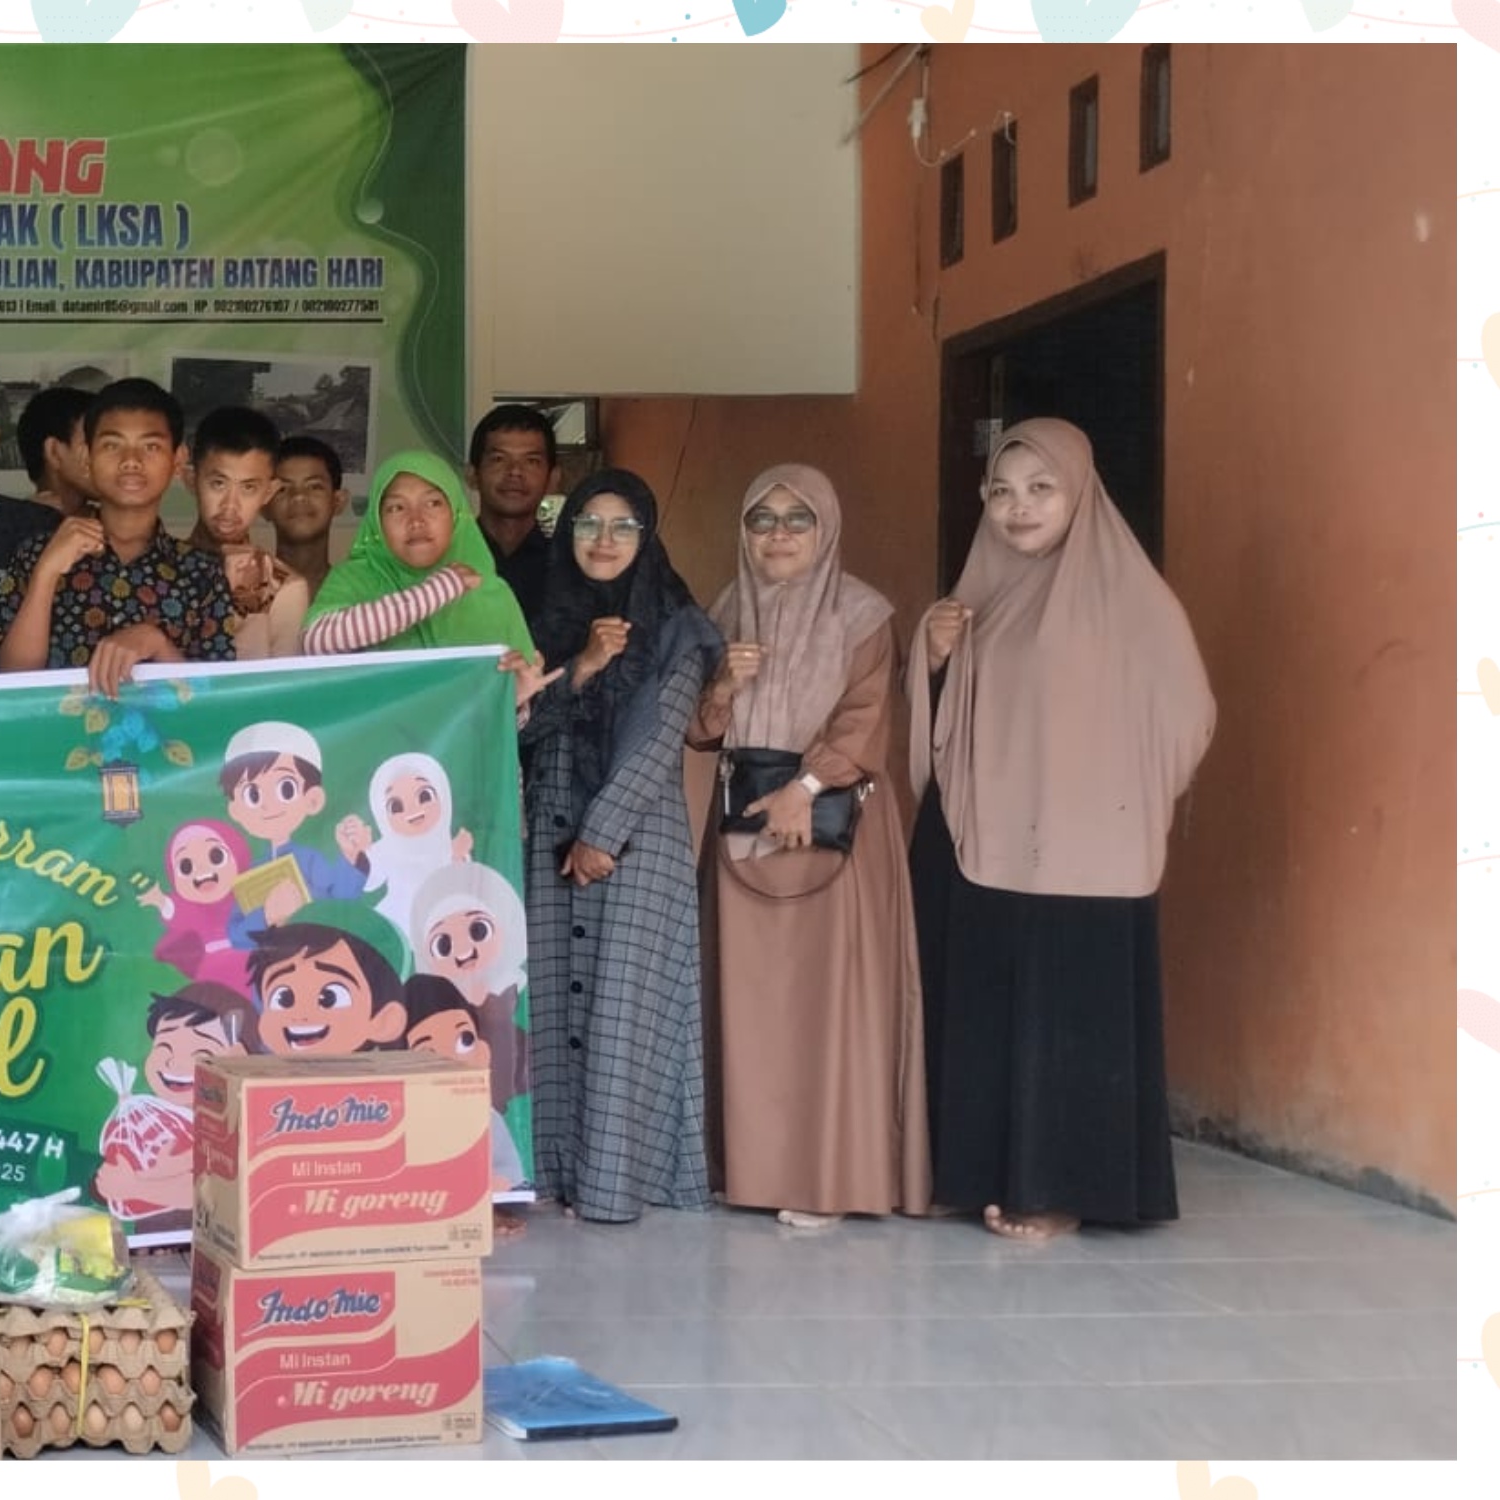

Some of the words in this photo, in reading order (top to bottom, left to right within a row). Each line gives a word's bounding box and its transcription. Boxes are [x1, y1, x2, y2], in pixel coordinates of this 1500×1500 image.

[76, 205, 164, 248] LKSA
[74, 259, 214, 289] KABUPATEN
[223, 258, 318, 289] BATANG
[326, 257, 384, 288] HARI
[44, 1136, 64, 1159] H
[291, 1160, 310, 1177] Mi
[313, 1160, 362, 1177] Instan
[340, 1189, 449, 1219] goreng
[279, 1352, 298, 1370] Mi
[301, 1352, 351, 1370] Instan
[329, 1381, 439, 1412] goreng
